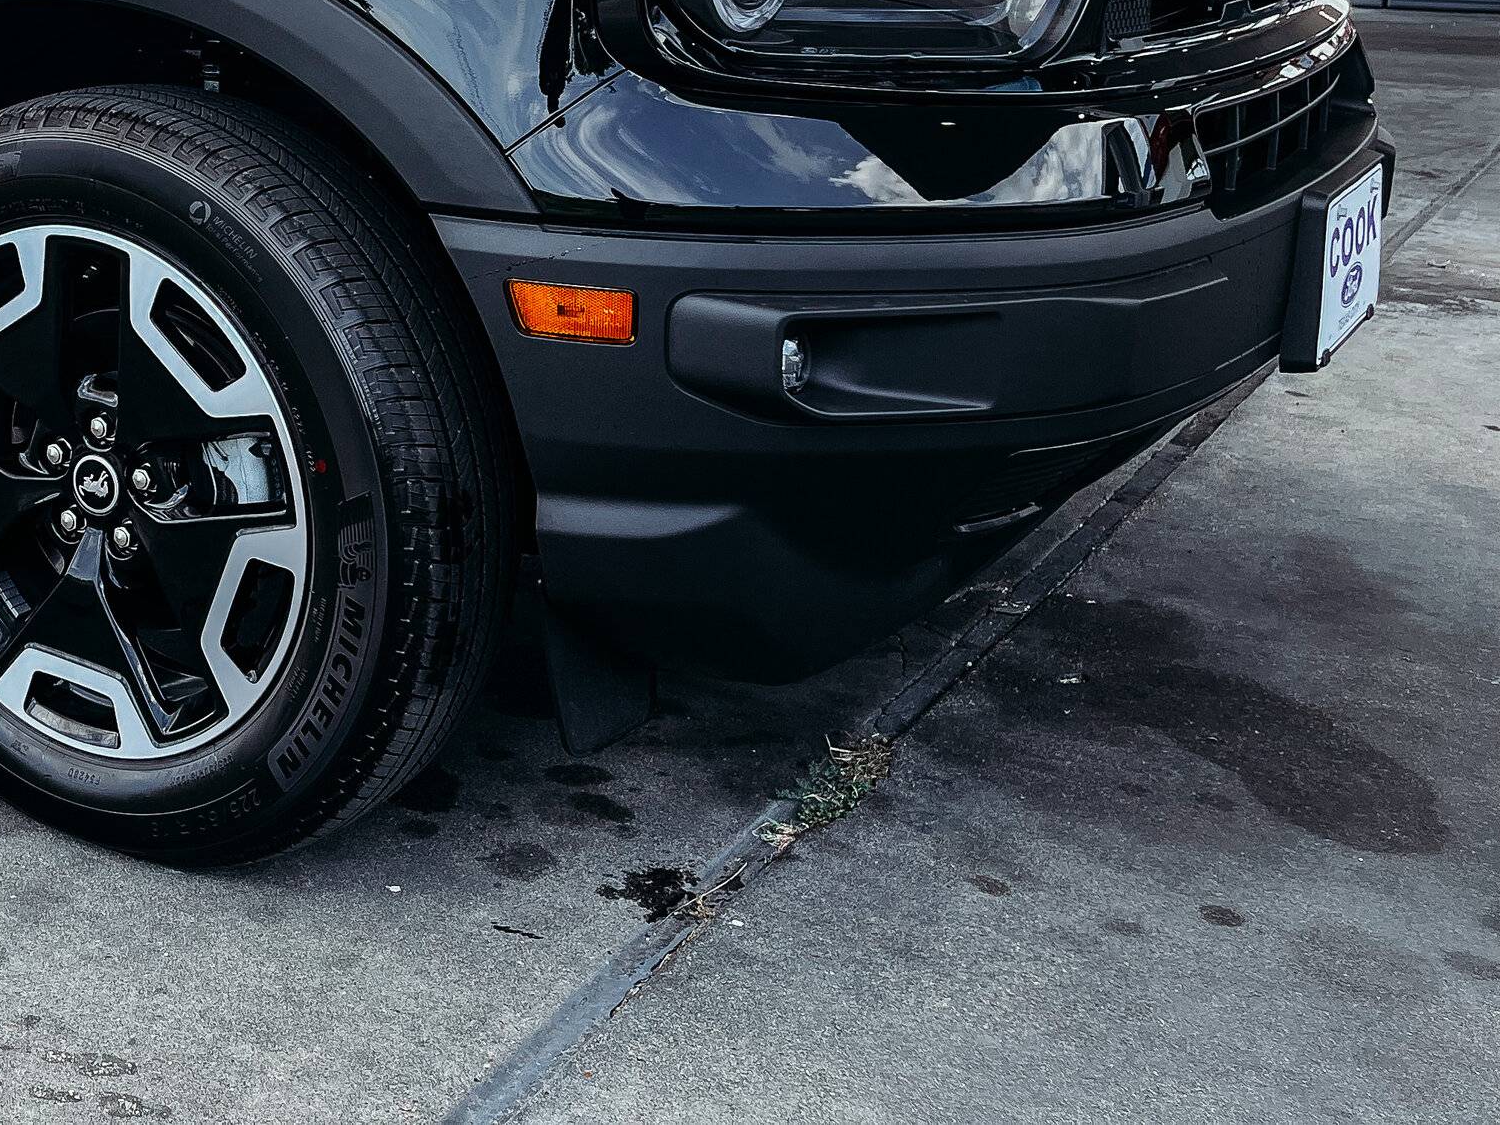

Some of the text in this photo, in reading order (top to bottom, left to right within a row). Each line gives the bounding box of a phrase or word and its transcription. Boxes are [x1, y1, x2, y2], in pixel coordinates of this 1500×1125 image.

[213, 216, 258, 259] MICHELIN
[1329, 194, 1378, 278] COOK
[275, 595, 367, 779] MICHELIN
